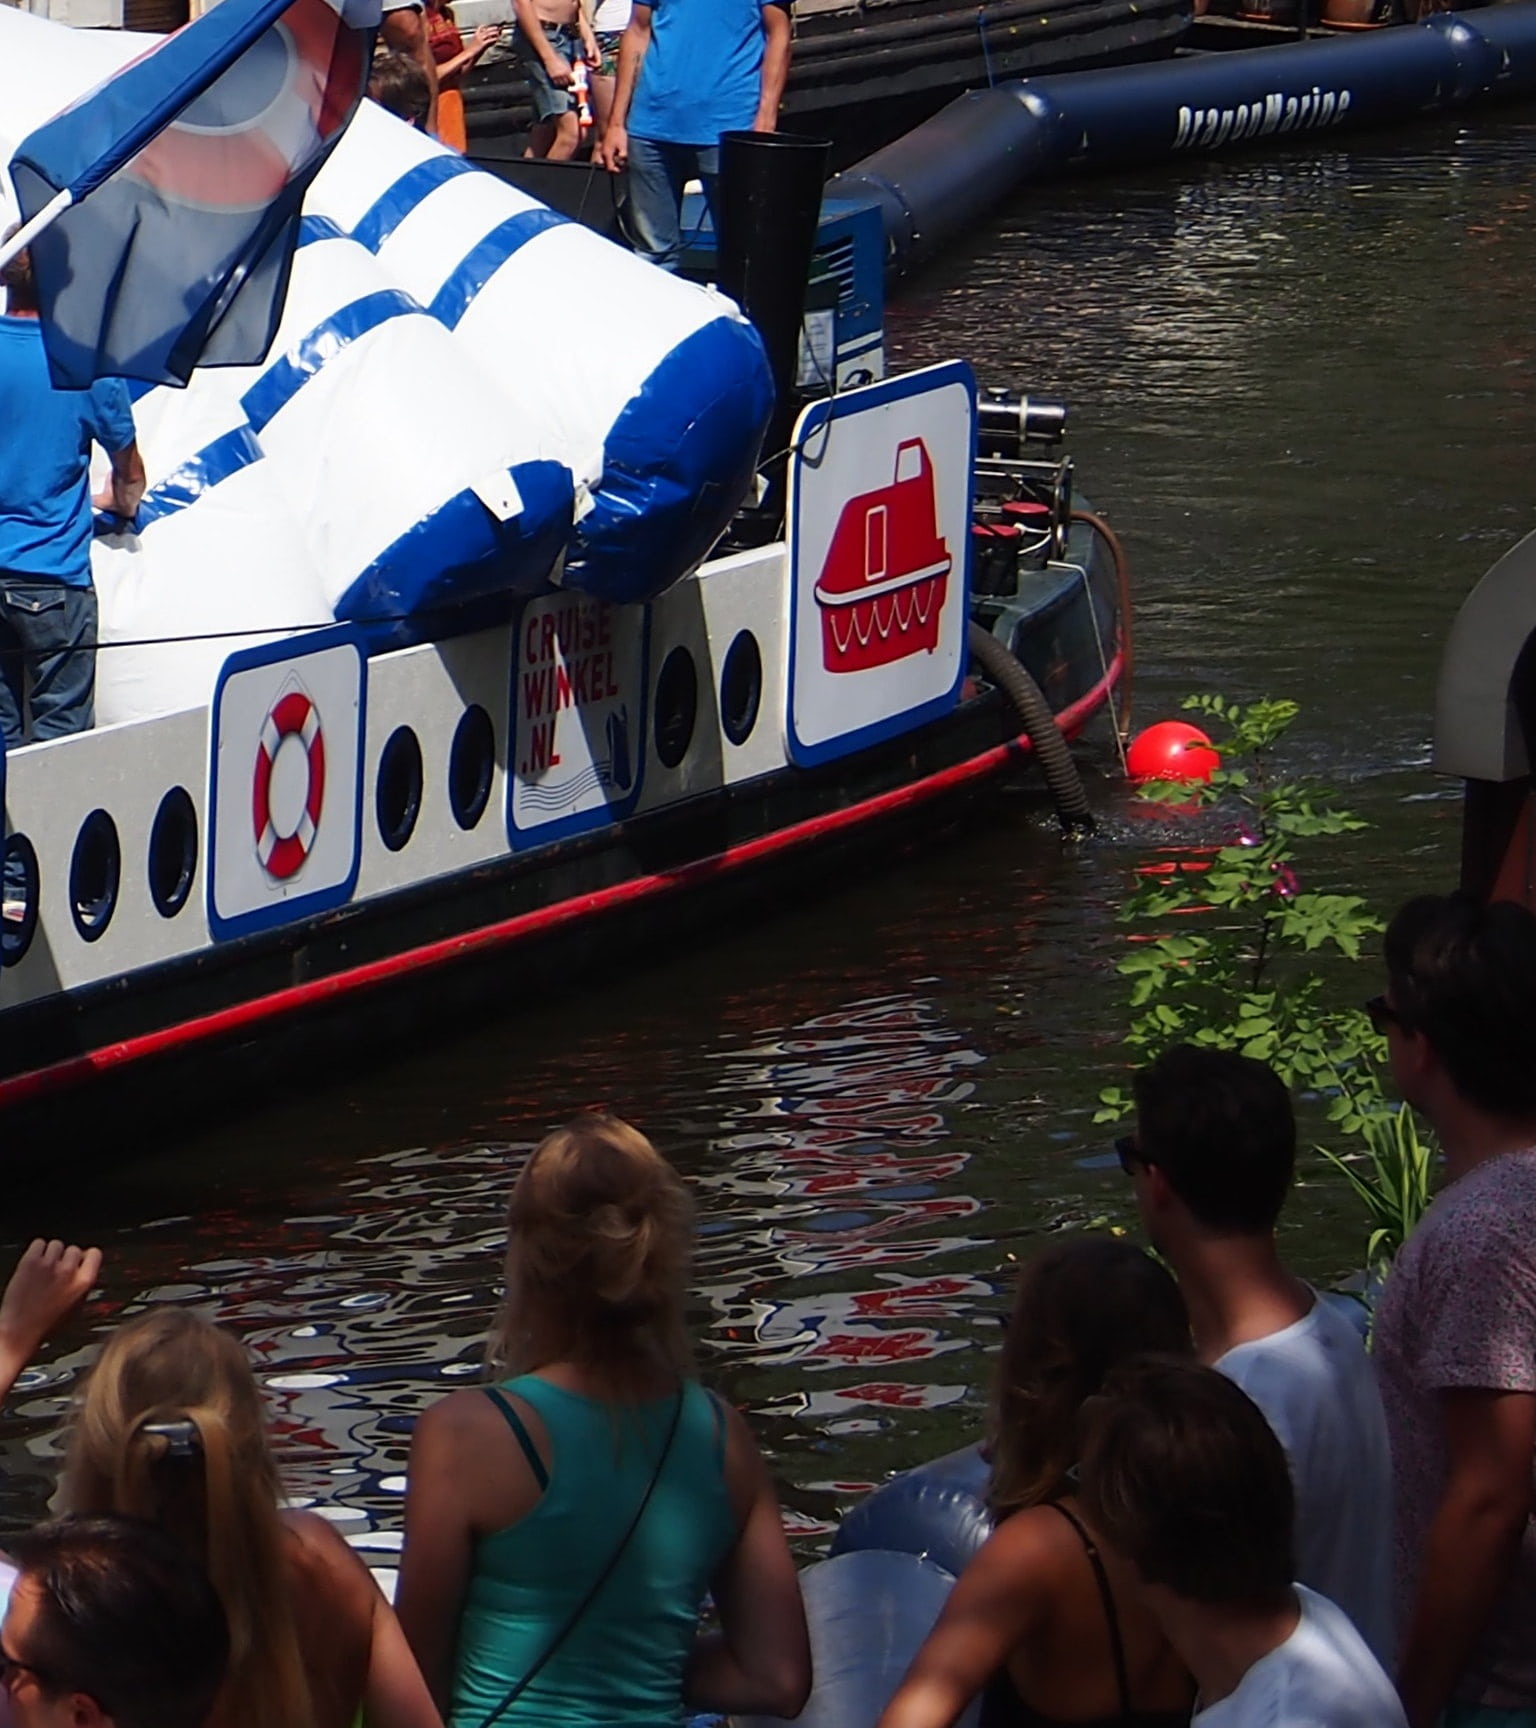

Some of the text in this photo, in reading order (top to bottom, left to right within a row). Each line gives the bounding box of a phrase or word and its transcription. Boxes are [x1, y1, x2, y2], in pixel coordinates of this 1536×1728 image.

[1172, 87, 1351, 150] DragonMarine
[526, 604, 611, 665] CRUISE
[524, 652, 619, 720] WINKEL
[522, 720, 560, 774] .NL
